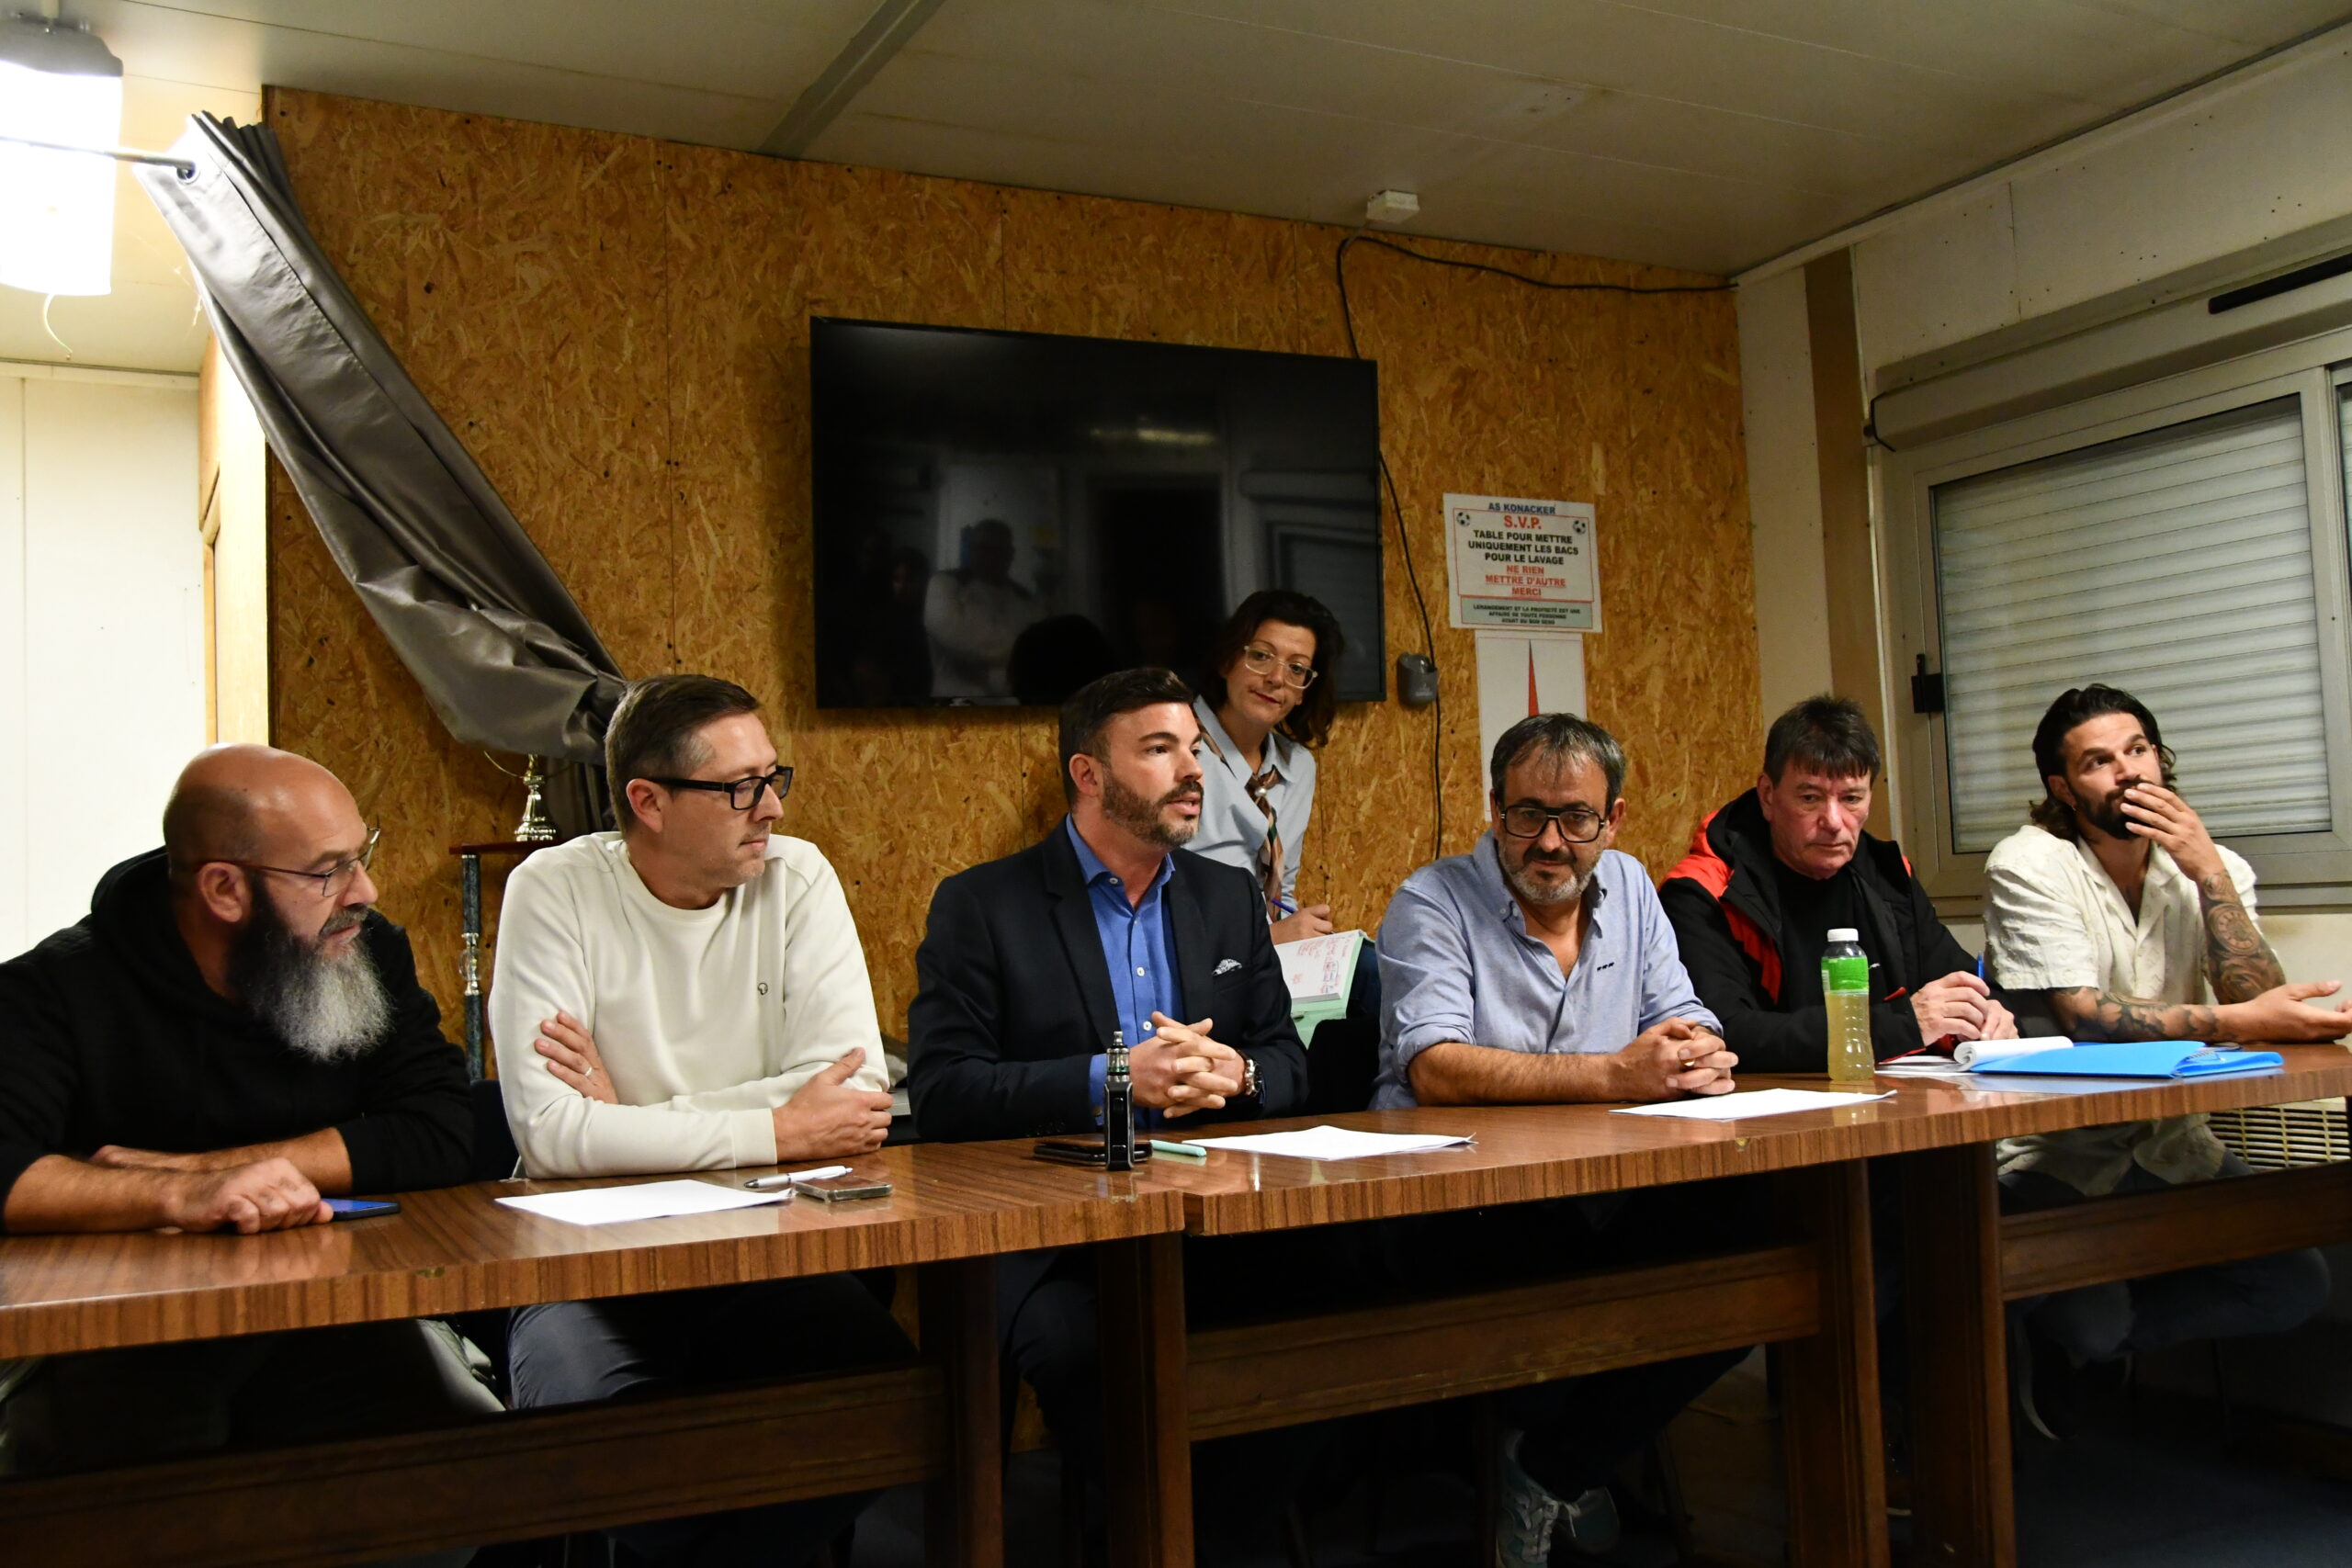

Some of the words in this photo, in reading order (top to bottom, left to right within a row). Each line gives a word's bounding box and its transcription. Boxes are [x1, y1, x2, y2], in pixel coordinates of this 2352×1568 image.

[1488, 502, 1501, 511] AS
[1503, 502, 1556, 514] KONACKER
[1504, 514, 1542, 529] S.V.P.
[1473, 529, 1504, 540] TABLE
[1506, 532, 1532, 542] POUR
[1535, 534, 1573, 544] METTRE
[1468, 540, 1532, 552] UNIQUEMENT
[1534, 544, 1552, 553] LES
[1555, 546, 1579, 556] BACS
[1485, 552, 1511, 562] POUR
[1514, 554, 1525, 563] LE
[1528, 555, 1565, 565] LAVAGE
[1507, 565, 1520, 574] NE
[1522, 566, 1544, 574] RIEN
[1485, 574, 1524, 584] METTRE
[1527, 576, 1566, 587] D'AUTRE
[1511, 587, 1542, 596] MERCI
